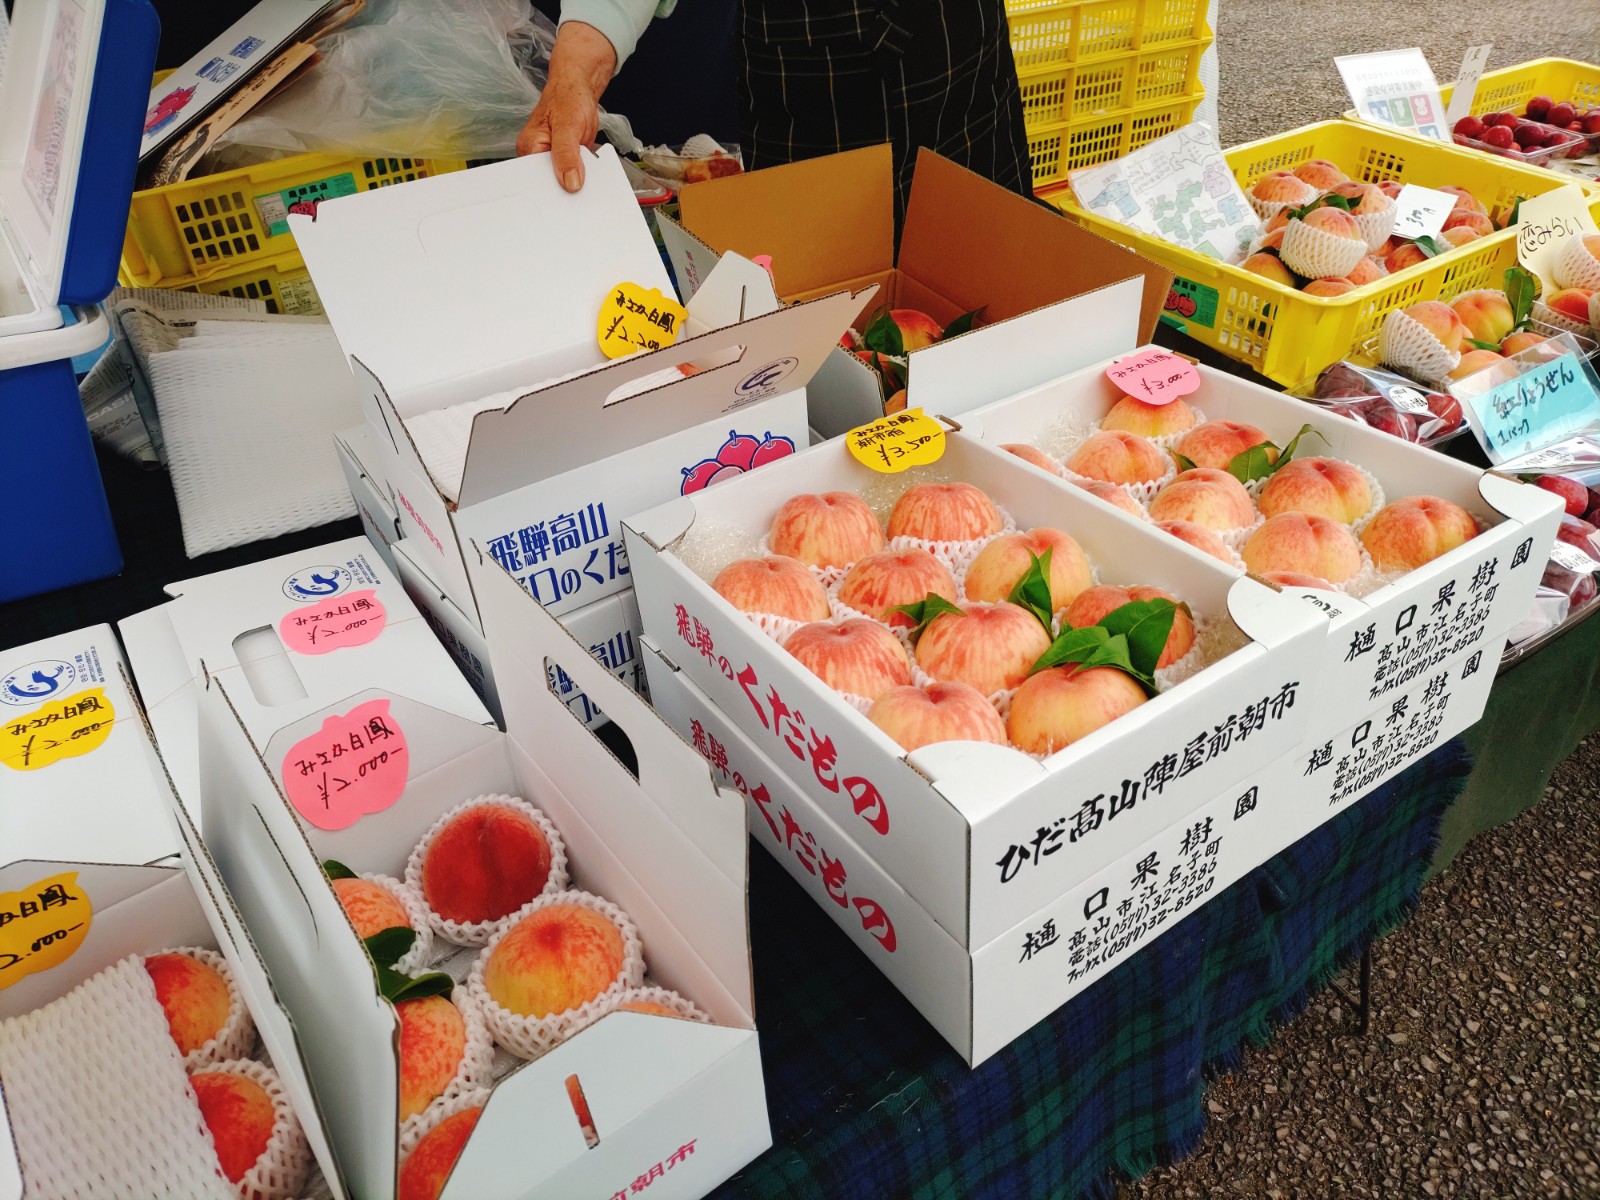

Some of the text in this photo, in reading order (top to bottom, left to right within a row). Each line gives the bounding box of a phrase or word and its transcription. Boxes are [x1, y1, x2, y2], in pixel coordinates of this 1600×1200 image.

[1519, 217, 1584, 260] 恋みらい
[1492, 362, 1575, 420] 紅りょうぜん
[1498, 419, 1530, 447] 1パック
[486, 502, 610, 572] 飛騨高山
[1344, 537, 1534, 663] 樋口果樹園
[674, 602, 890, 836] 飛騨のくだもの
[1303, 650, 1483, 777] 樋口果樹園
[1019, 786, 1259, 964] 樋口果樹園
